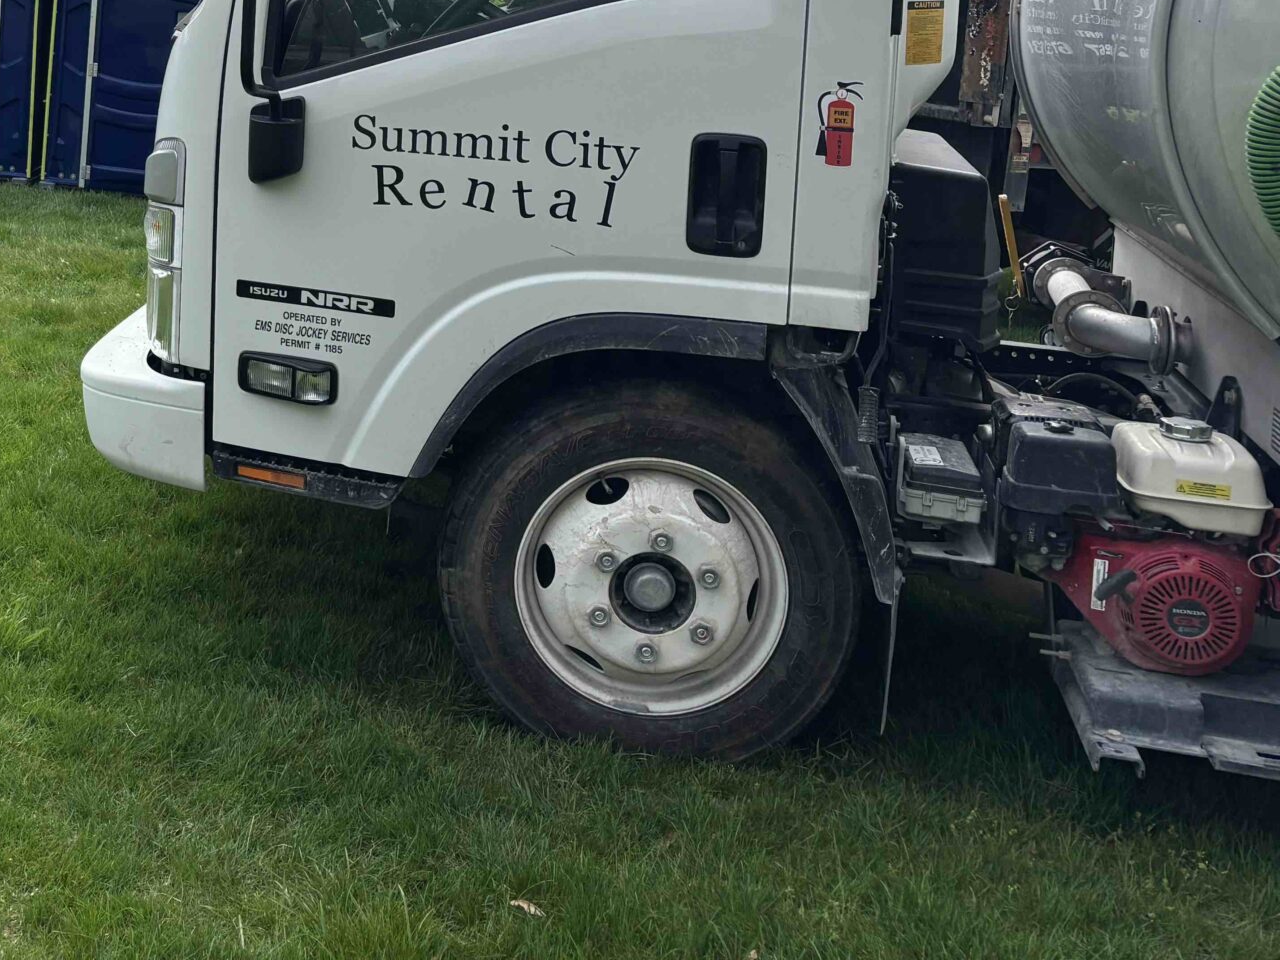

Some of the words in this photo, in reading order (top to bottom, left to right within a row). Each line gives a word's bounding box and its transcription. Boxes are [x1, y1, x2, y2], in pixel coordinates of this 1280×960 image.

[351, 114, 530, 164] Summit
[544, 130, 640, 181] City
[371, 164, 617, 228] Rental
[250, 286, 288, 298] ISUZU
[300, 290, 375, 313] NRR
[283, 311, 327, 325] OPERATED
[331, 318, 342, 327] BY
[254, 320, 272, 332] EMS
[274, 323, 294, 336] DISC
[296, 325, 328, 340] JOCKEY
[331, 330, 371, 346] SERVICES
[280, 338, 311, 350] PERMIT
[315, 343, 320, 351] #
[324, 344, 343, 354] 1185
[1172, 608, 1207, 617] HONDA
